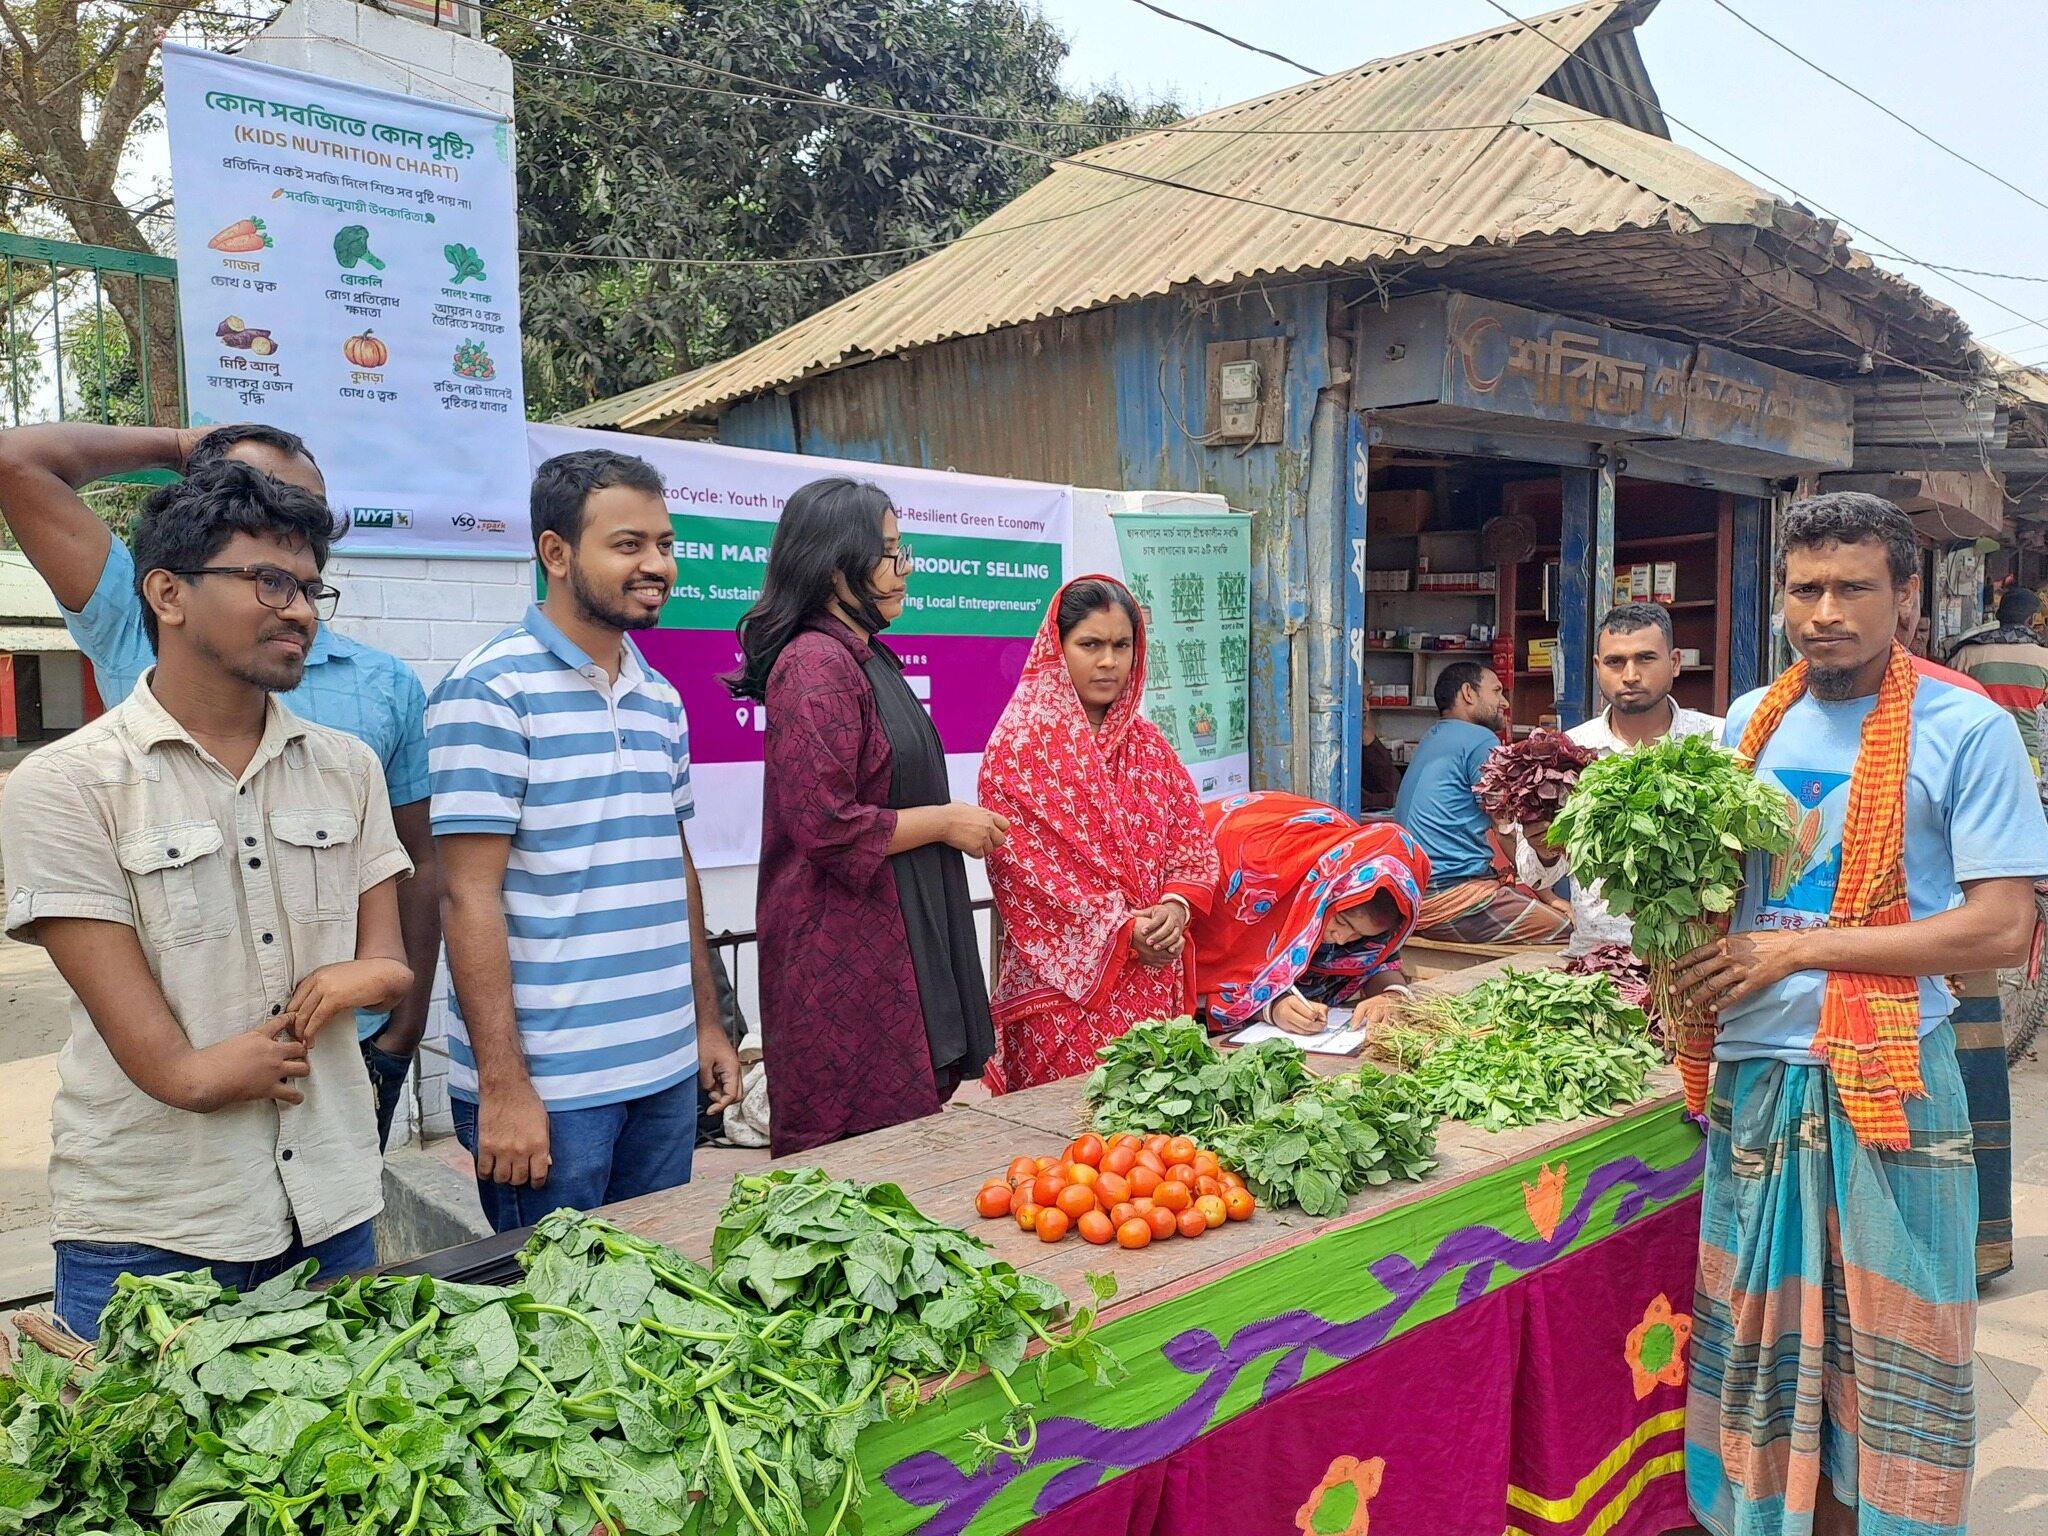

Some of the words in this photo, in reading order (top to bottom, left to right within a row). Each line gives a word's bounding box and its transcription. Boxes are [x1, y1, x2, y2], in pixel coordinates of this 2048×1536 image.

[205, 91, 266, 118] কোন
[268, 102, 367, 137] সবজিতে
[372, 123, 423, 149] কোন
[427, 131, 474, 161] পুষ্টি?
[234, 125, 288, 148] (KIDS
[292, 135, 392, 168] NUTRITION
[396, 156, 459, 182] CHART)
[222, 156, 270, 174] প্রতিদিন
[273, 165, 304, 180] একই
[305, 171, 339, 186] সবজি
[341, 174, 368, 191] দিলে
[370, 180, 395, 195] শিশু
[396, 188, 413, 199] সব
[415, 189, 435, 205] পুষ্টি
[436, 195, 456, 207] পায়
[457, 199, 472, 210] না।
[284, 190, 320, 206] সবজি
[321, 196, 367, 213] অনুযায়ী
[368, 201, 424, 223] উপকারিতা
[223, 258, 261, 273] গাজর
[211, 275, 240, 288] চোখ
[242, 279, 252, 289] ও
[254, 280, 278, 293] ত্বক
[340, 273, 384, 288] ব্রোকলি
[325, 289, 351, 301] রোগ
[353, 291, 400, 307] প্রতিরোধ
[441, 287, 468, 300] পালং
[469, 292, 492, 303] শাক
[344, 304, 381, 318] ক্ষমতা
[434, 303, 473, 318] আয়রন
[475, 310, 482, 319] ও
[432, 312, 471, 328] তৈরিতে
[470, 322, 505, 334] সহায়ক
[219, 355, 248, 371] মিষ্টি
[249, 361, 282, 376] আলু
[262, 380, 293, 392] ওজন
[350, 371, 384, 384] কুমড়া
[238, 389, 265, 406] বৃদ্ধি
[339, 387, 364, 398] চোখ
[367, 390, 375, 399] ও
[376, 391, 398, 402] ত্বক
[433, 380, 461, 394] রঙিন
[484, 387, 512, 400] মানেই
[441, 394, 478, 409] পুষ্টিকর
[480, 401, 508, 413] খাবার
[663, 487, 723, 505] coCycle:
[727, 491, 768, 508] Youth
[356, 509, 393, 523] NYF
[452, 514, 476, 528] VSO
[895, 506, 958, 524] d-Resilient
[960, 512, 994, 527] Green
[999, 515, 1045, 533] Economy
[673, 540, 714, 560] EEN
[721, 544, 771, 563] MAR
[986, 561, 1049, 579] SELLING
[670, 584, 705, 601] ucts,
[709, 584, 763, 601] Sustain
[926, 594, 956, 609] Local
